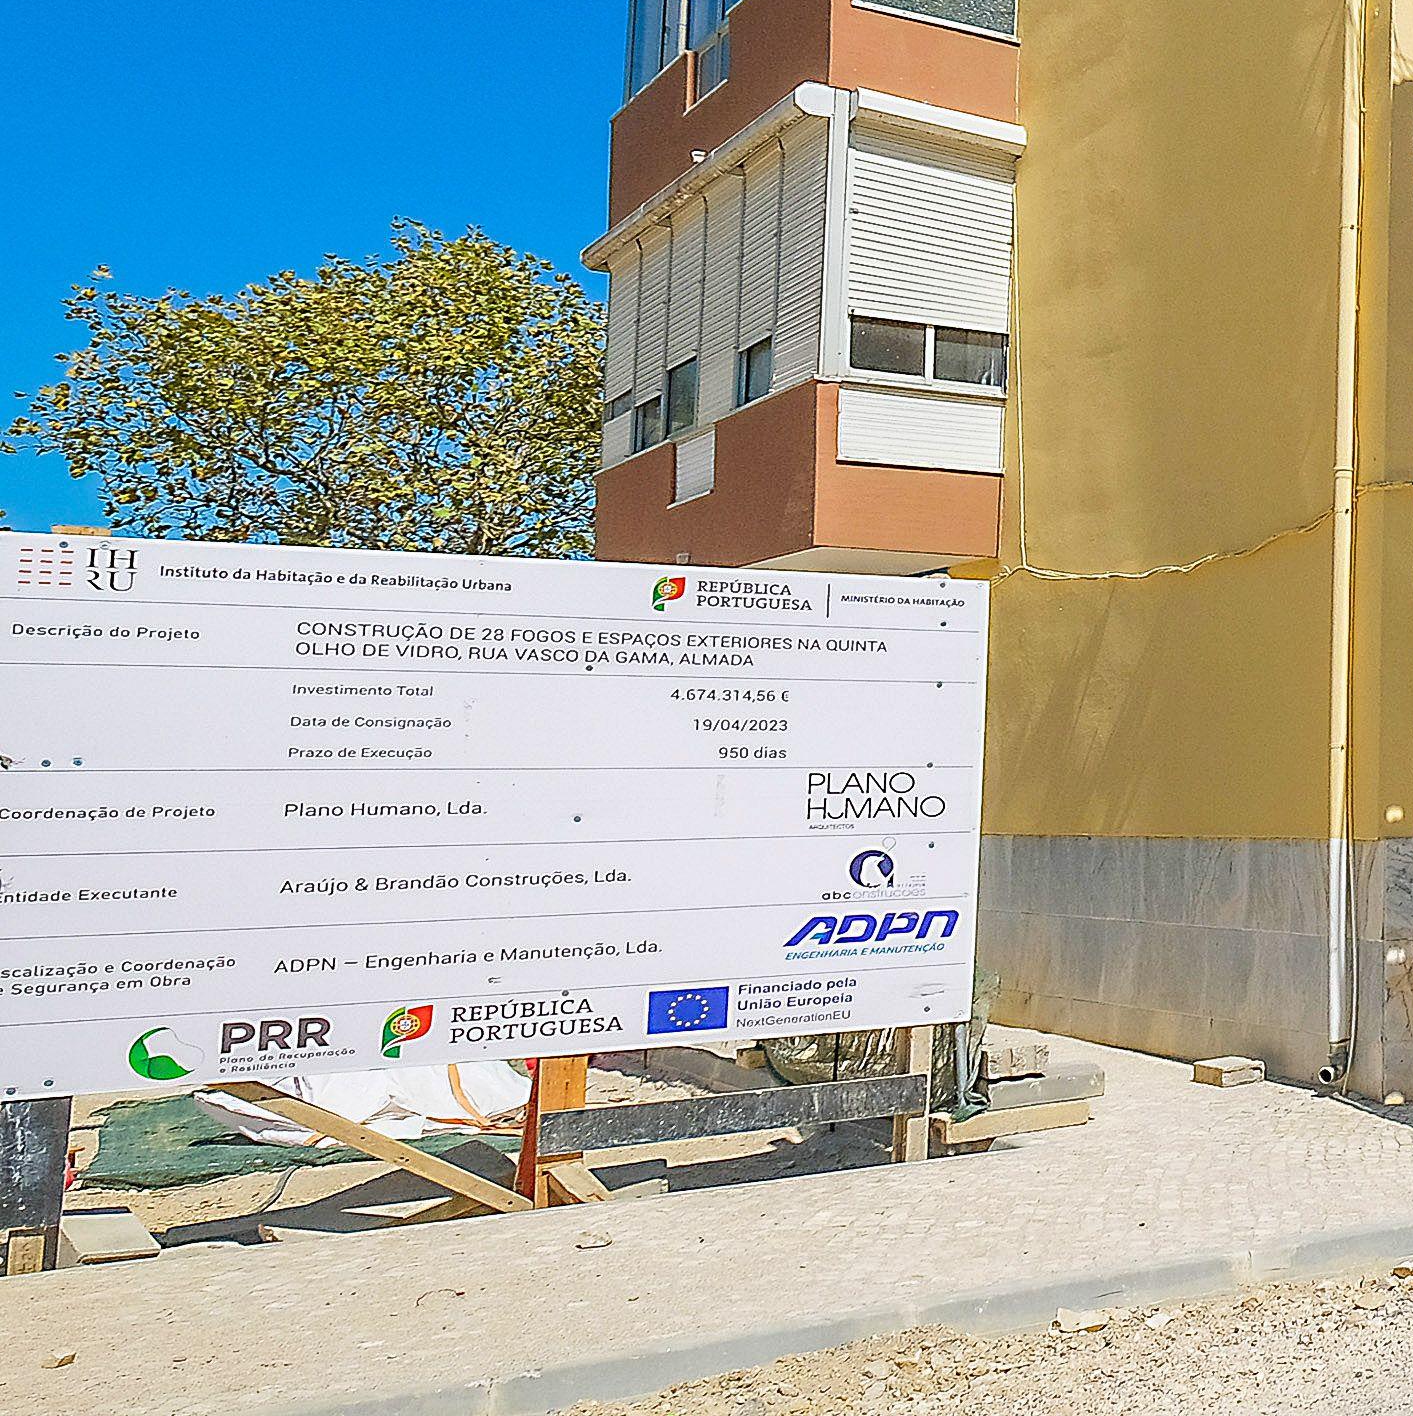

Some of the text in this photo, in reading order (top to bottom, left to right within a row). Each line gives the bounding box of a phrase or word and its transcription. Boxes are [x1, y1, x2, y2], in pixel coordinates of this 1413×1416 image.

[160, 566, 228, 579] Instituto
[232, 569, 251, 580] da
[256, 570, 332, 585] Habitação
[349, 574, 366, 585] da
[371, 575, 458, 591] Reabilitação
[462, 580, 512, 591] Urbana
[697, 579, 792, 595] REPÚBLICA
[696, 595, 813, 611] PORTUGUESA
[841, 593, 895, 604] MINISTÉRIO
[913, 598, 965, 607] HABITAÇÃO
[13, 624, 200, 641] Descrição do Projeto
[297, 622, 888, 653] CONSTRUÇÃO DE 28 FOGOS E ESPAÇOS EXTERIORES NA QUINTA
[295, 642, 754, 666] OLHO DE VIDRO, RUA VASCO DA GAMA, ALMADA
[292, 684, 434, 697] Investimento Total
[670, 688, 776, 703] 4.674.314,56
[290, 716, 452, 730] Data de Consignação
[693, 718, 788, 732] 19/04/2023
[288, 747, 433, 760] Prazo de Execução
[718, 746, 787, 759] 950 dias
[808, 772, 915, 795] PLANO
[0, 806, 216, 821] Coordenação de Projeto
[284, 801, 488, 817] Plano Humano, Lda.
[806, 795, 946, 820] HUMANO
[279, 869, 632, 896] Araújo & Brandão Construções, Lda.
[78, 887, 178, 901] Executante
[783, 909, 959, 947] ADPN
[274, 957, 336, 973] ADPN
[365, 950, 477, 970] Engenharia
[500, 943, 620, 962] Manutenção,
[626, 940, 663, 955] Lda.
[785, 948, 858, 961] ENGENHARIA
[869, 943, 945, 955] MANUTENÇÃO
[0, 963, 97, 978] scalização
[121, 956, 236, 973] Coordenação
[11, 981, 109, 997] Segurança
[116, 979, 143, 989] em
[150, 975, 191, 988] Obra
[738, 977, 857, 995] Financiado pela
[451, 999, 593, 1023] REPÚBLICA
[737, 994, 853, 1011] União Europeia
[736, 1009, 852, 1029] NextGenerationEU
[220, 1017, 331, 1054] PRR
[450, 1016, 623, 1044] PORTUGUESA
[219, 1056, 254, 1064] Plano
